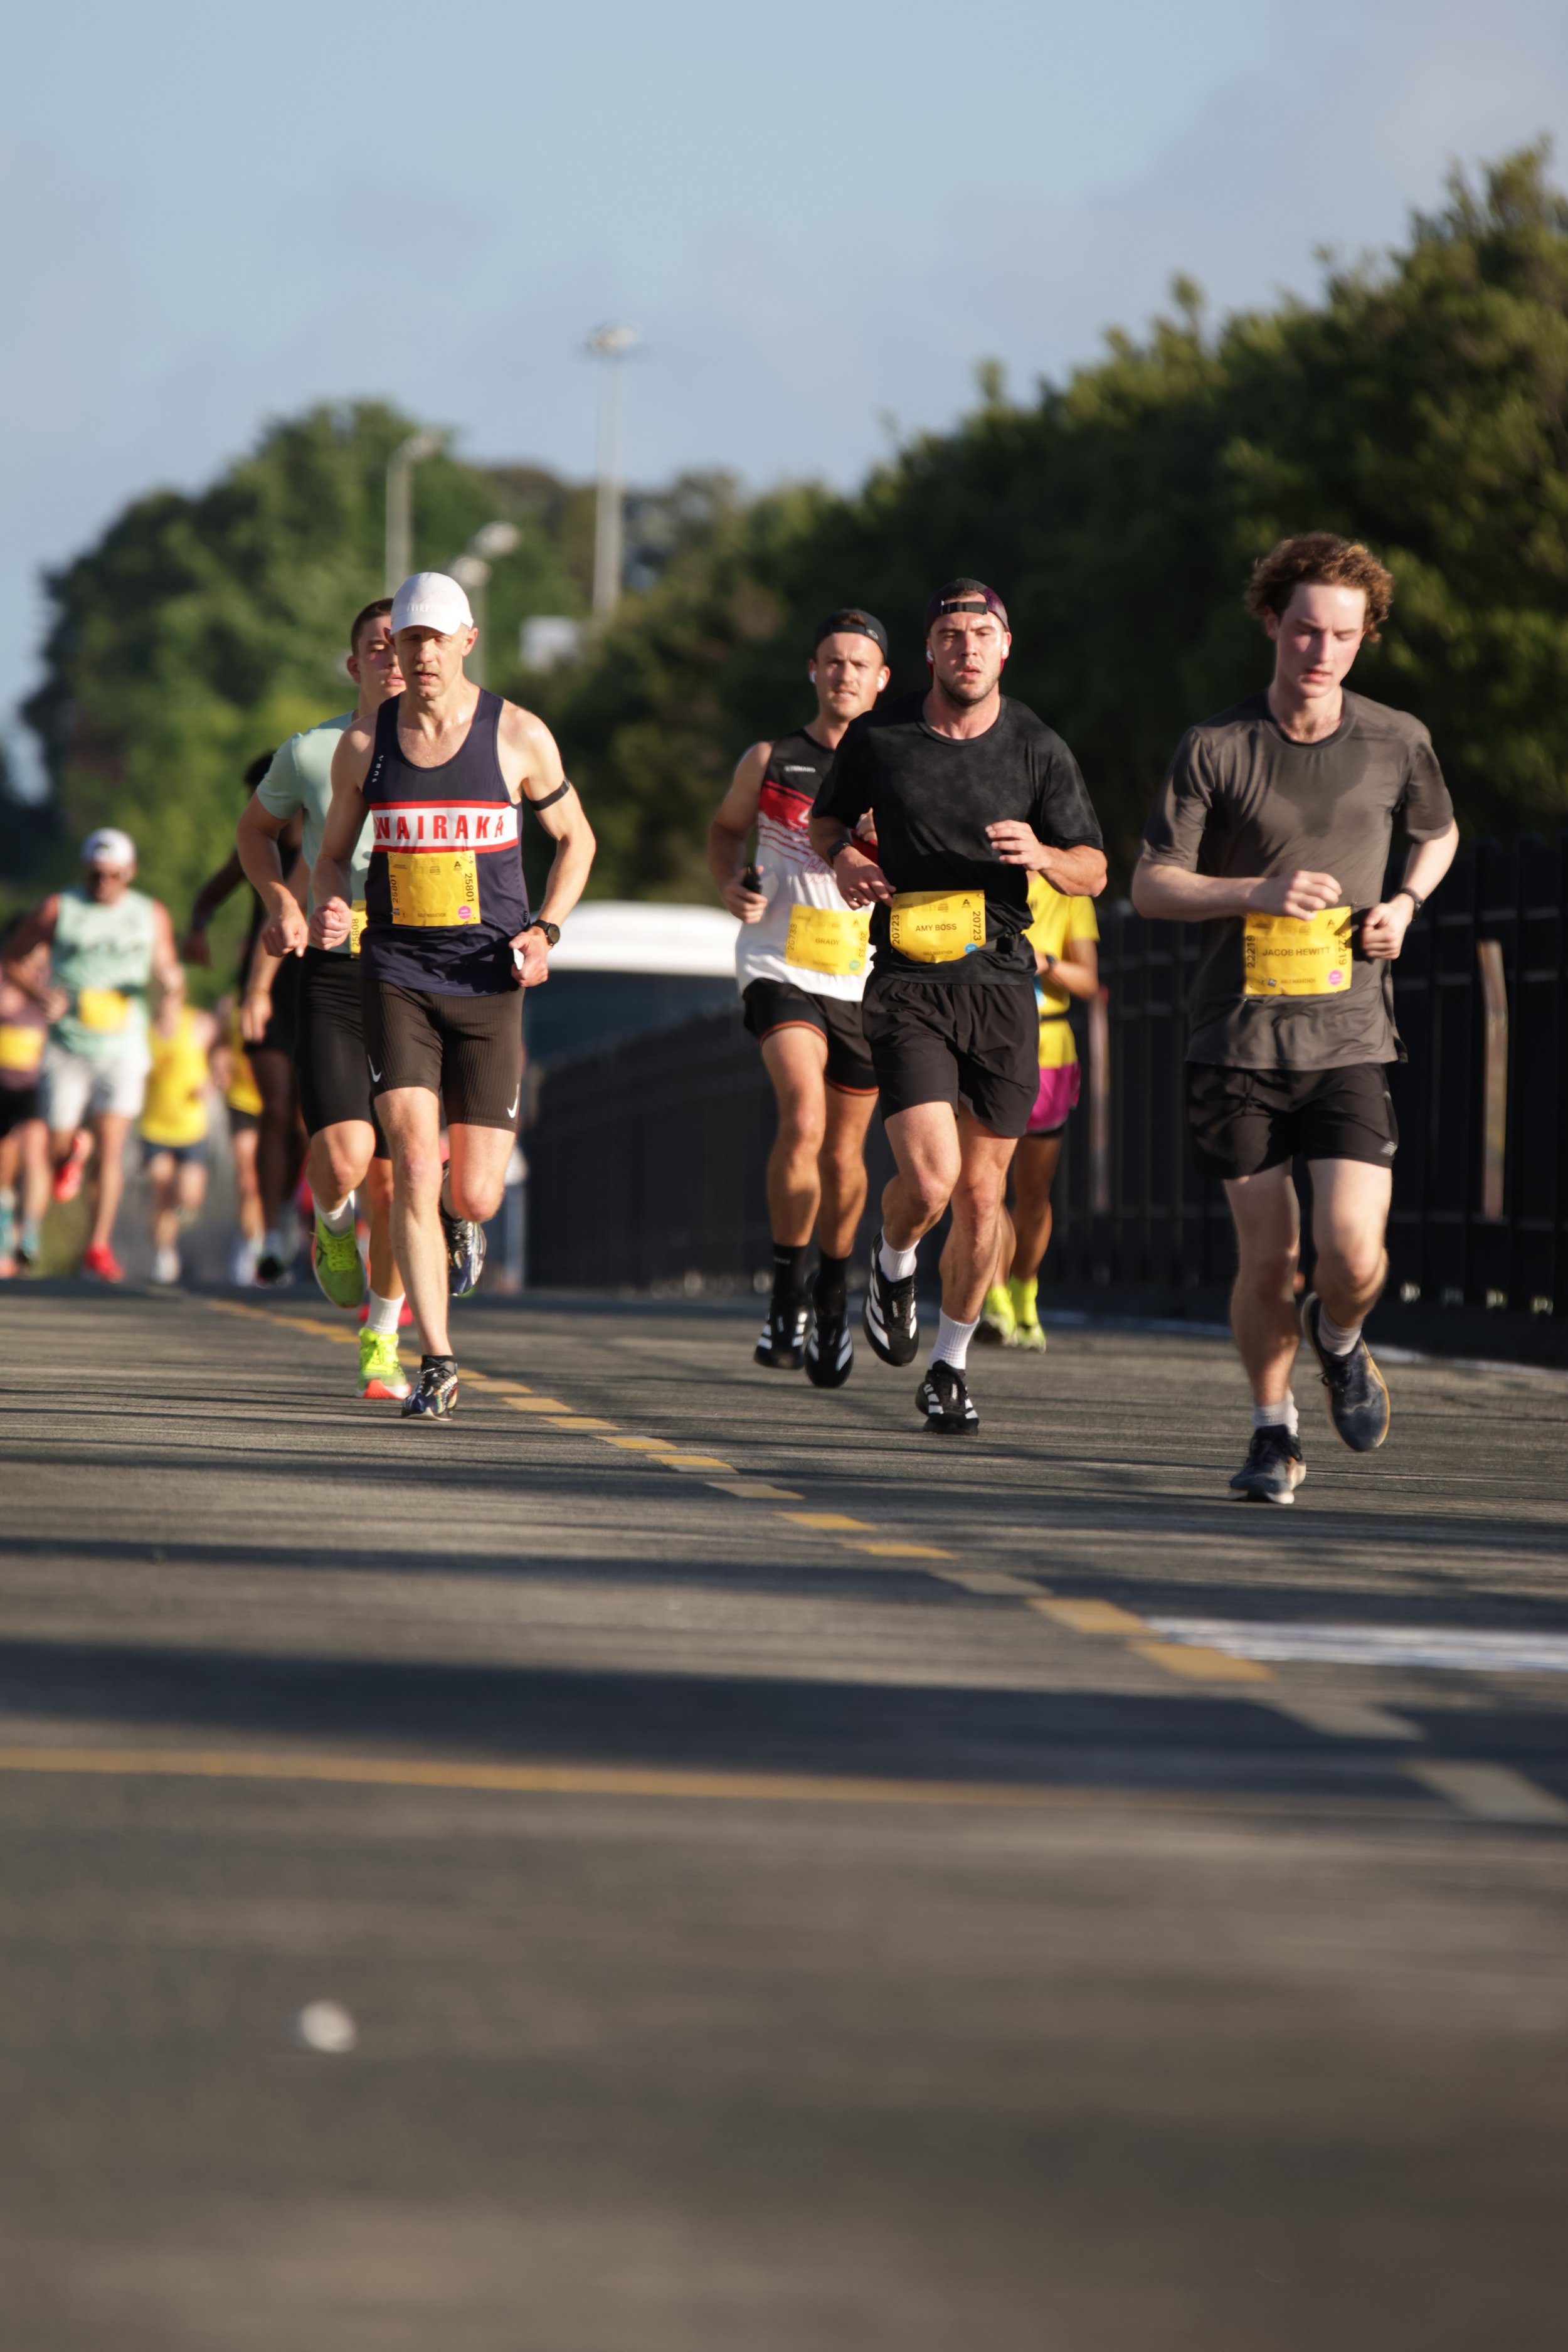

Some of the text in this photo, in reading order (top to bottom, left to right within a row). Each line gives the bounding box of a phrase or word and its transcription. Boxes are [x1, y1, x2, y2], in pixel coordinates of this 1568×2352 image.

[373, 815, 504, 840] WAIRAKA
[389, 874, 400, 903] 25801
[465, 873, 475, 902] 25801
[787, 923, 797, 951] 20733
[892, 914, 901, 945] 20723
[973, 911, 982, 941] 20723
[859, 931, 867, 958] 20733
[1246, 935, 1256, 968] 22219
[1262, 946, 1331, 956] JACOB HEWITT
[1338, 932, 1347, 965] 22219
